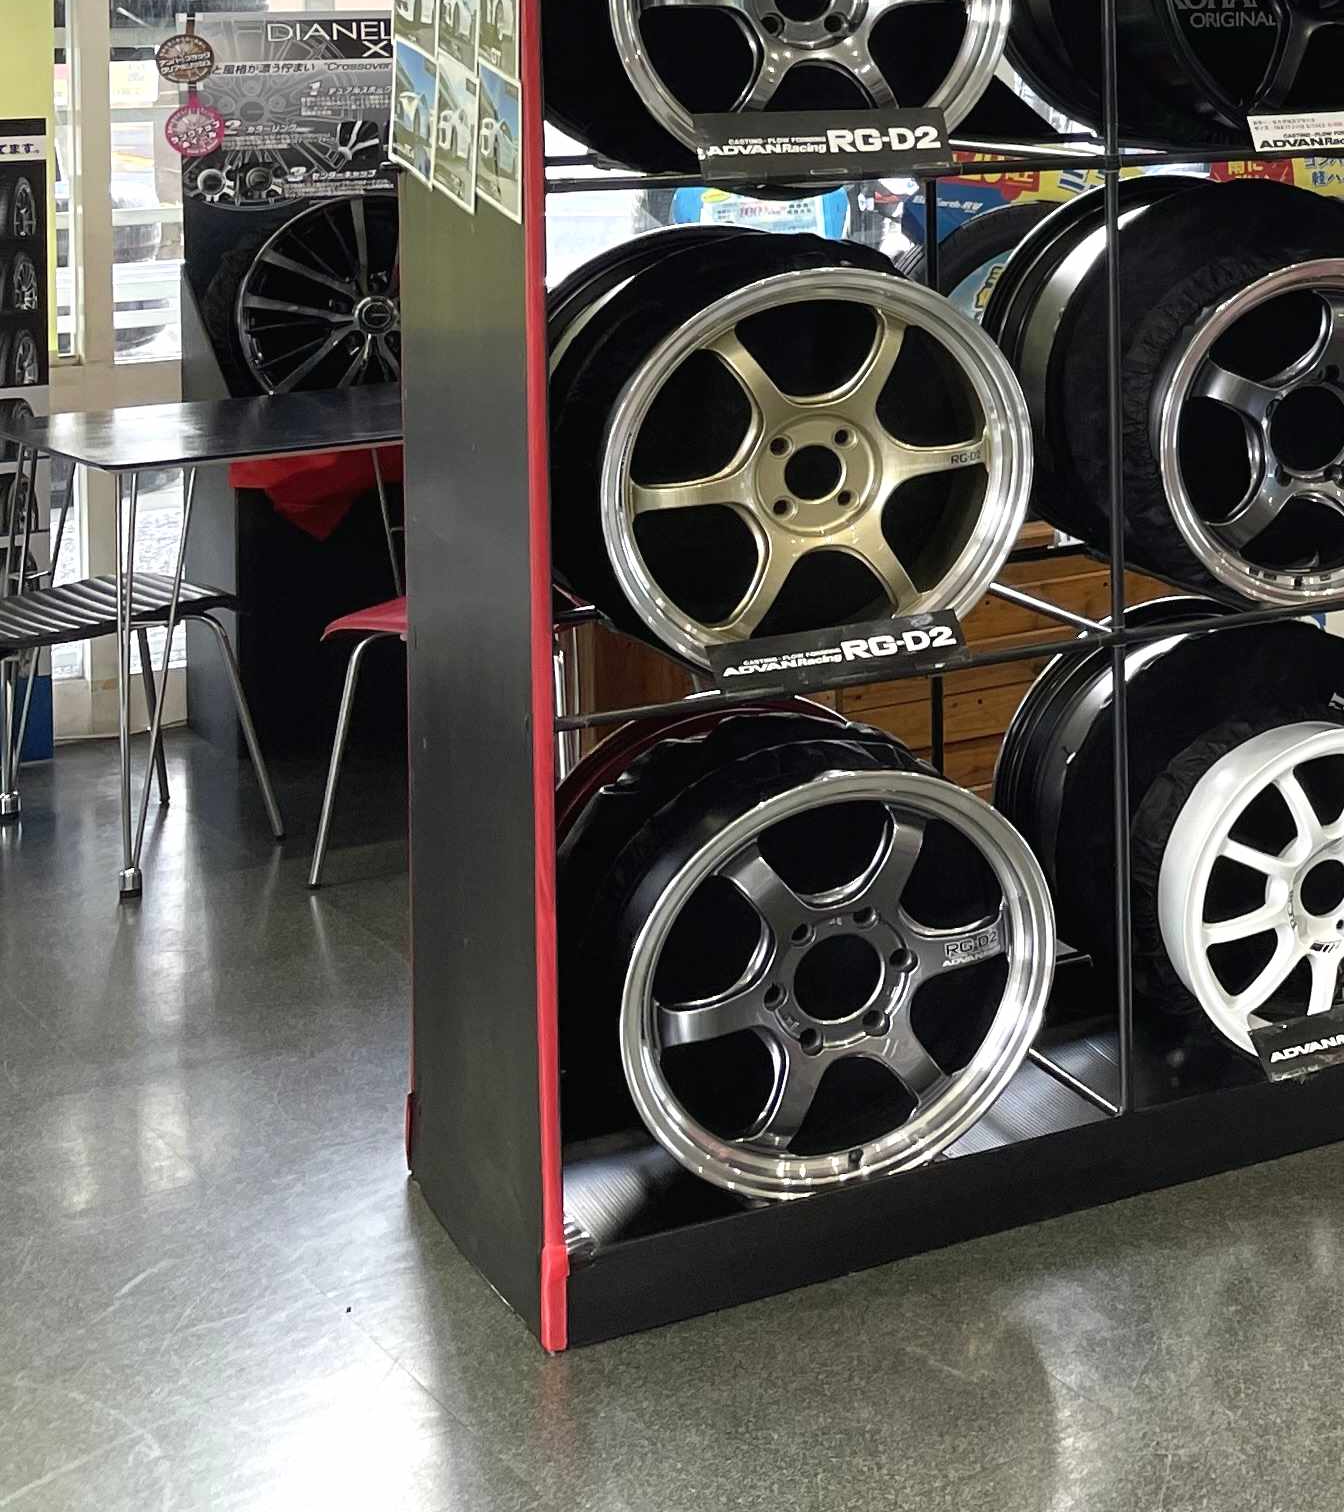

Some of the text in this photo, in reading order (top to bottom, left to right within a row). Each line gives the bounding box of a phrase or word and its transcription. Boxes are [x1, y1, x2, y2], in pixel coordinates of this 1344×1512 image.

[1190, 12, 1277, 29] ORIGINAL
[826, 126, 942, 153] RG-D2
[949, 450, 983, 466] RG-D2
[840, 626, 957, 662] RG-D2
[944, 929, 999, 958] RG-D2
[1270, 1034, 1335, 1065] ADVAN
